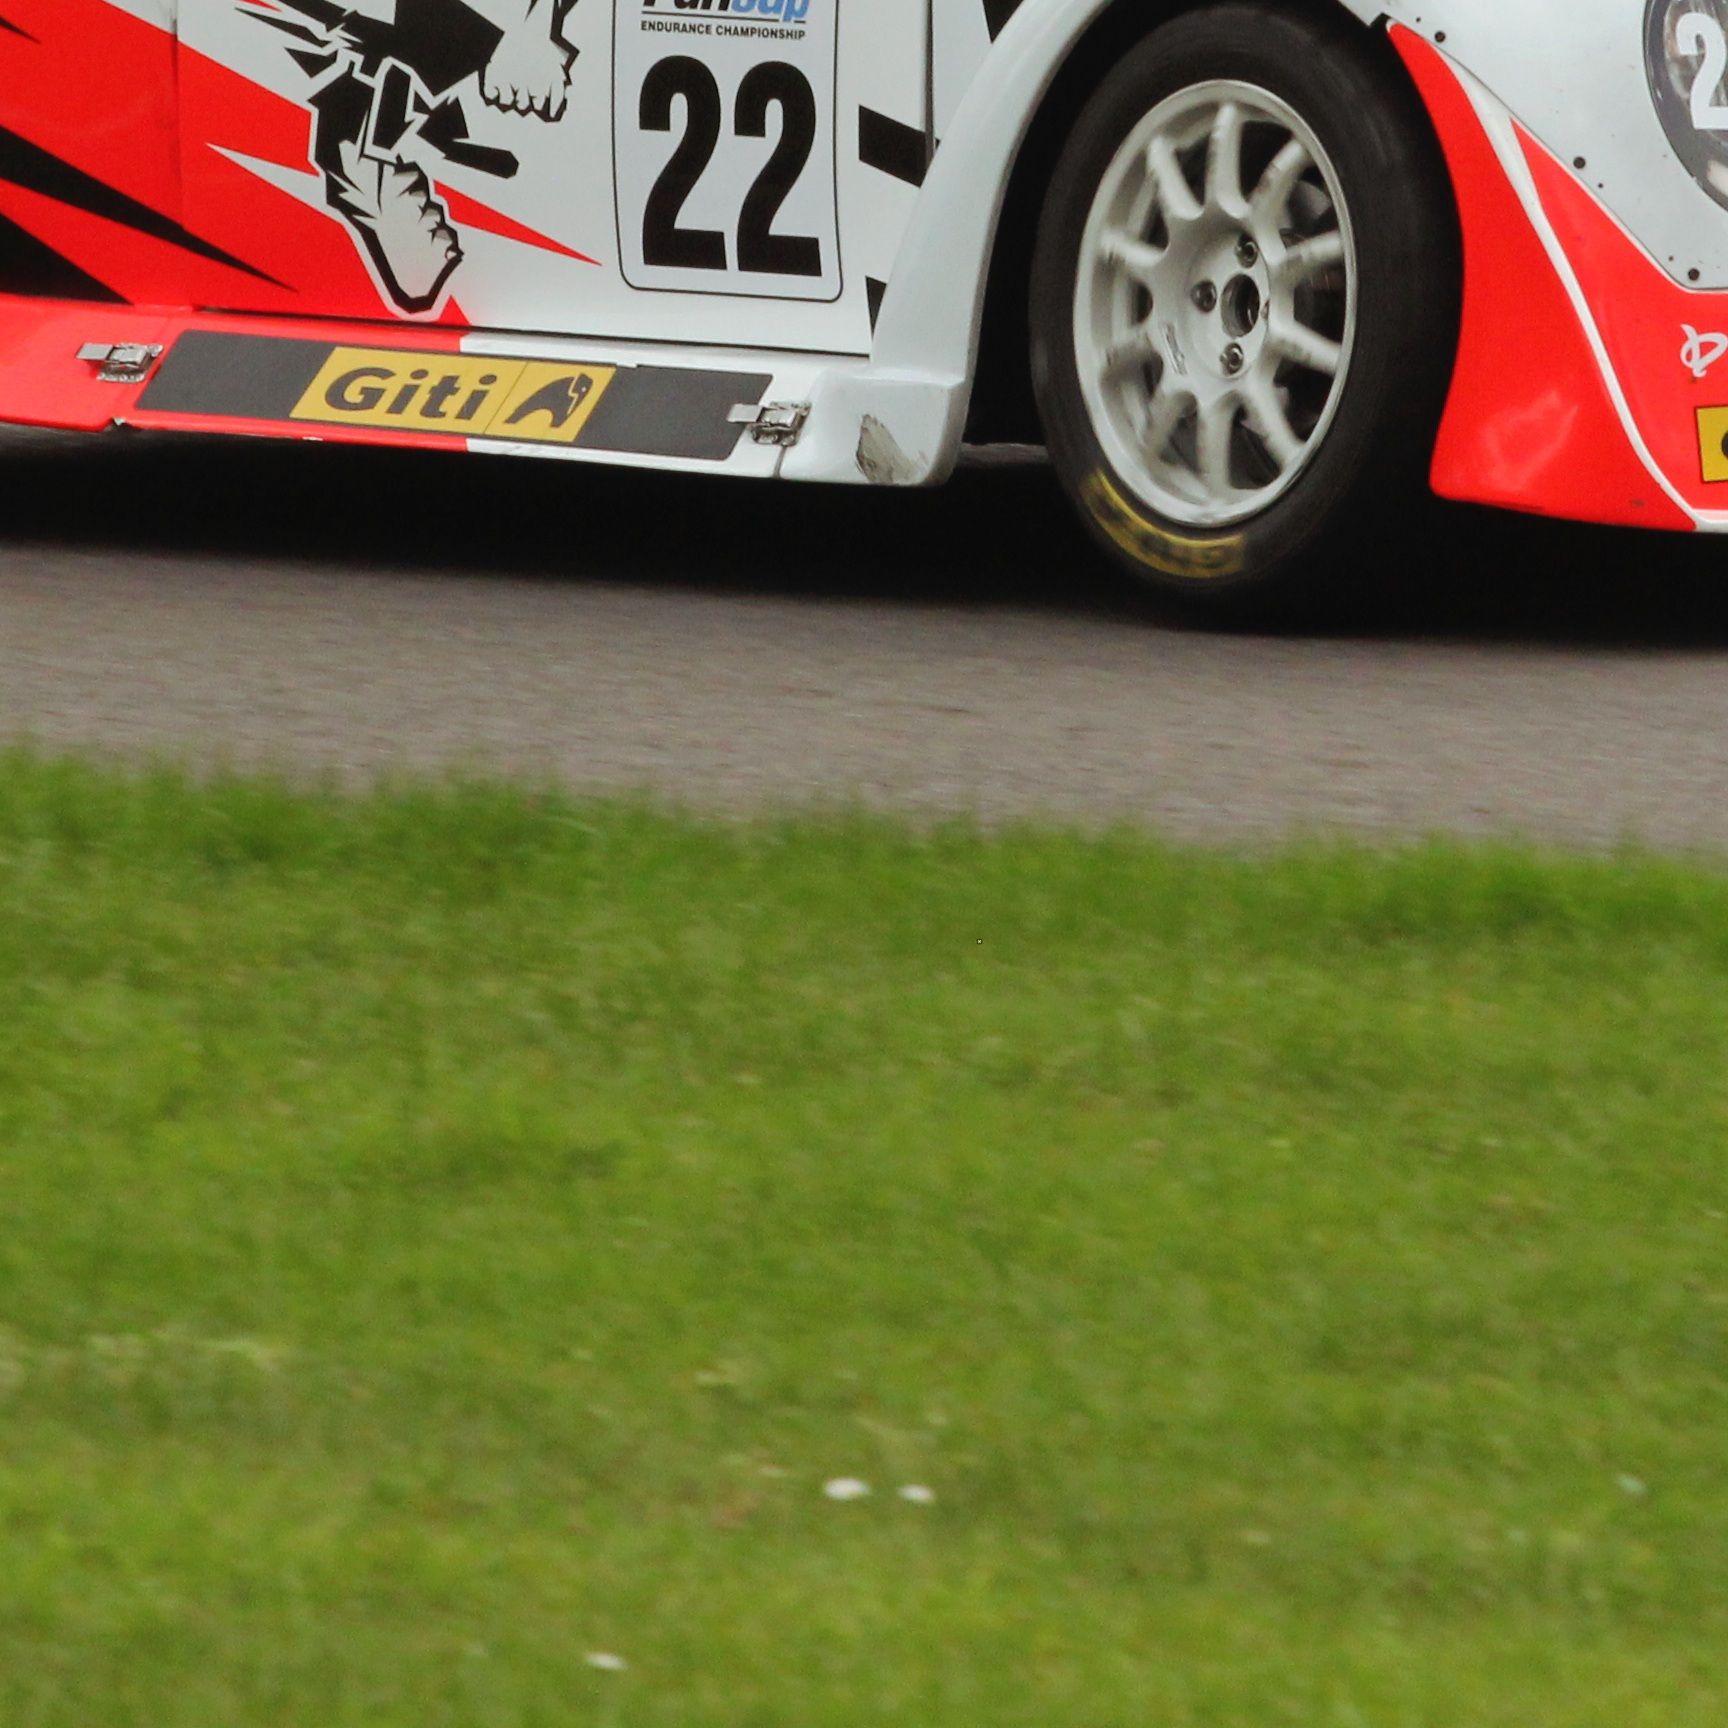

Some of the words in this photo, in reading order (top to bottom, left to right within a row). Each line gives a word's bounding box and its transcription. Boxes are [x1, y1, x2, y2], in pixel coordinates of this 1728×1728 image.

[640, 19, 713, 36] ENDURANCE
[715, 24, 806, 41] CHAMPIONSHIP
[637, 54, 823, 277] 22
[324, 367, 498, 421] Giti
